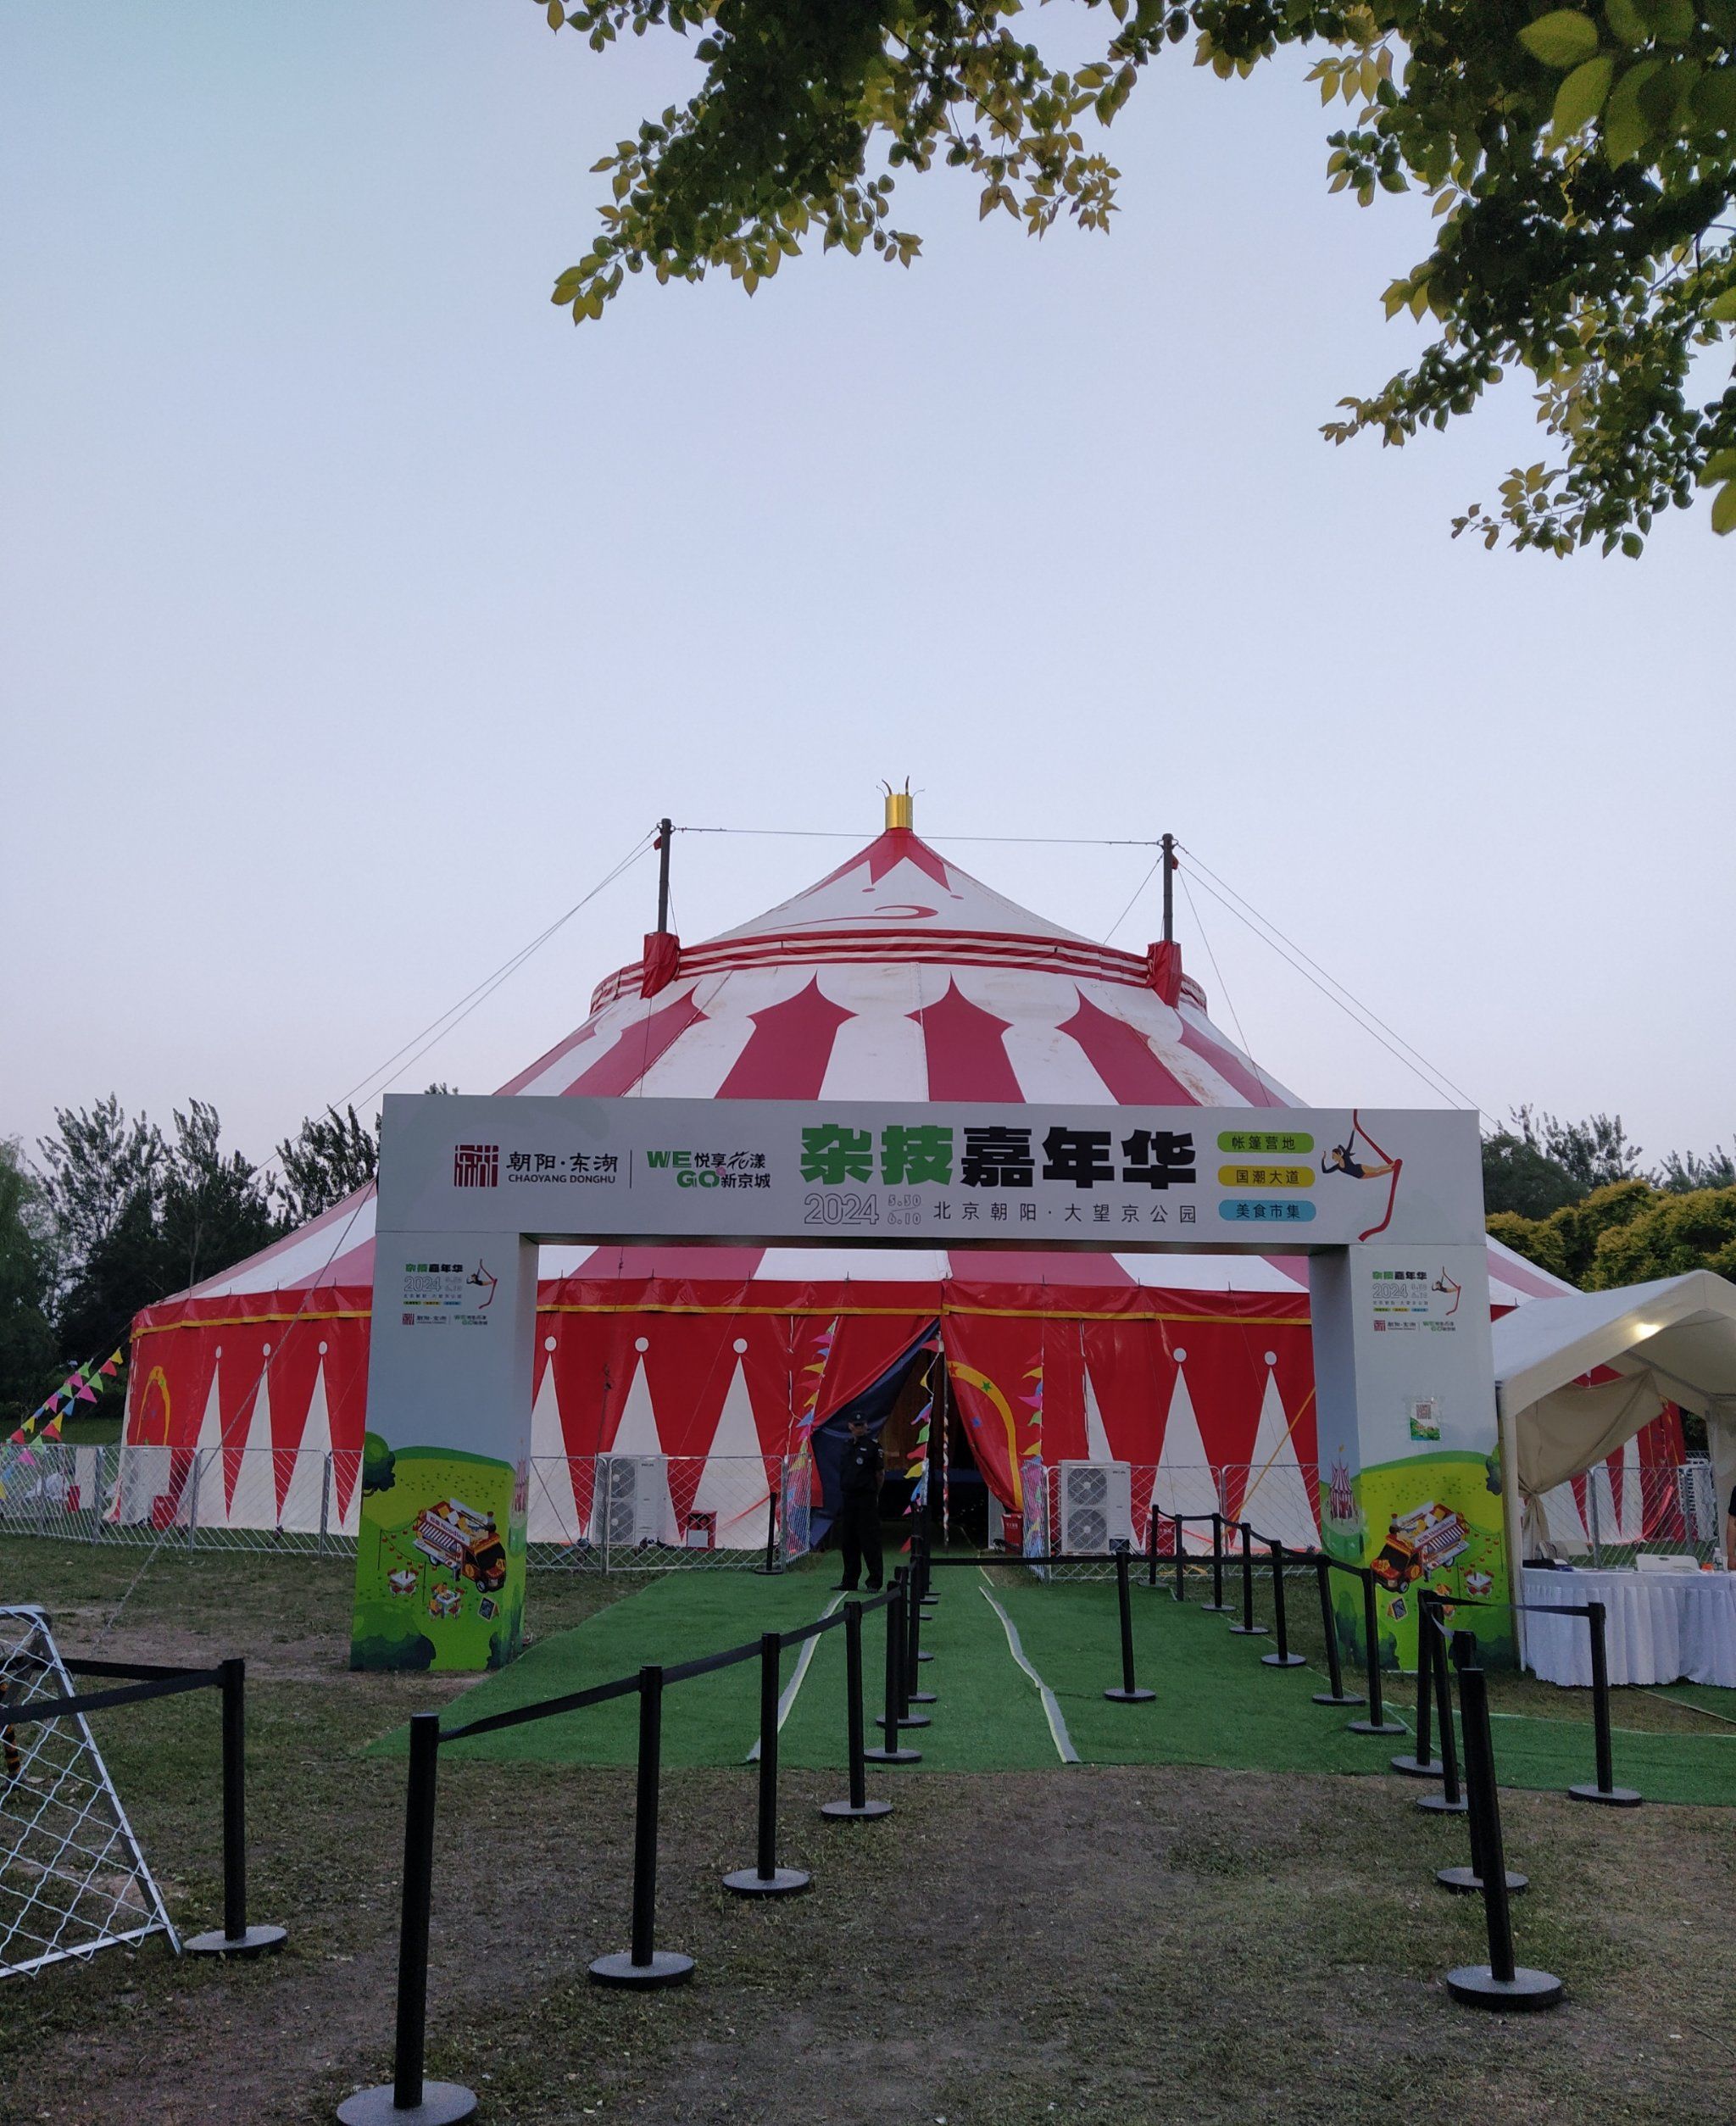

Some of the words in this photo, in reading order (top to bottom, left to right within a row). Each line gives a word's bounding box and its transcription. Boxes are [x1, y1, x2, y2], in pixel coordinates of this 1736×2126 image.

[1232, 1136, 1296, 1149] 帐篷营地
[647, 1151, 691, 1168] WE
[799, 1124, 1196, 1189] 杂技嘉年华
[509, 1174, 567, 1183] CHAOYANG
[570, 1175, 615, 1184] DONGHU
[721, 1173, 771, 1188] 新京城
[1236, 1170, 1299, 1184] 国潮大道
[804, 1193, 879, 1225] 2024
[1236, 1204, 1300, 1219] 美食市集
[887, 1212, 921, 1225] 6.10
[403, 1276, 442, 1292] 2024
[1372, 1283, 1409, 1299] 2024
